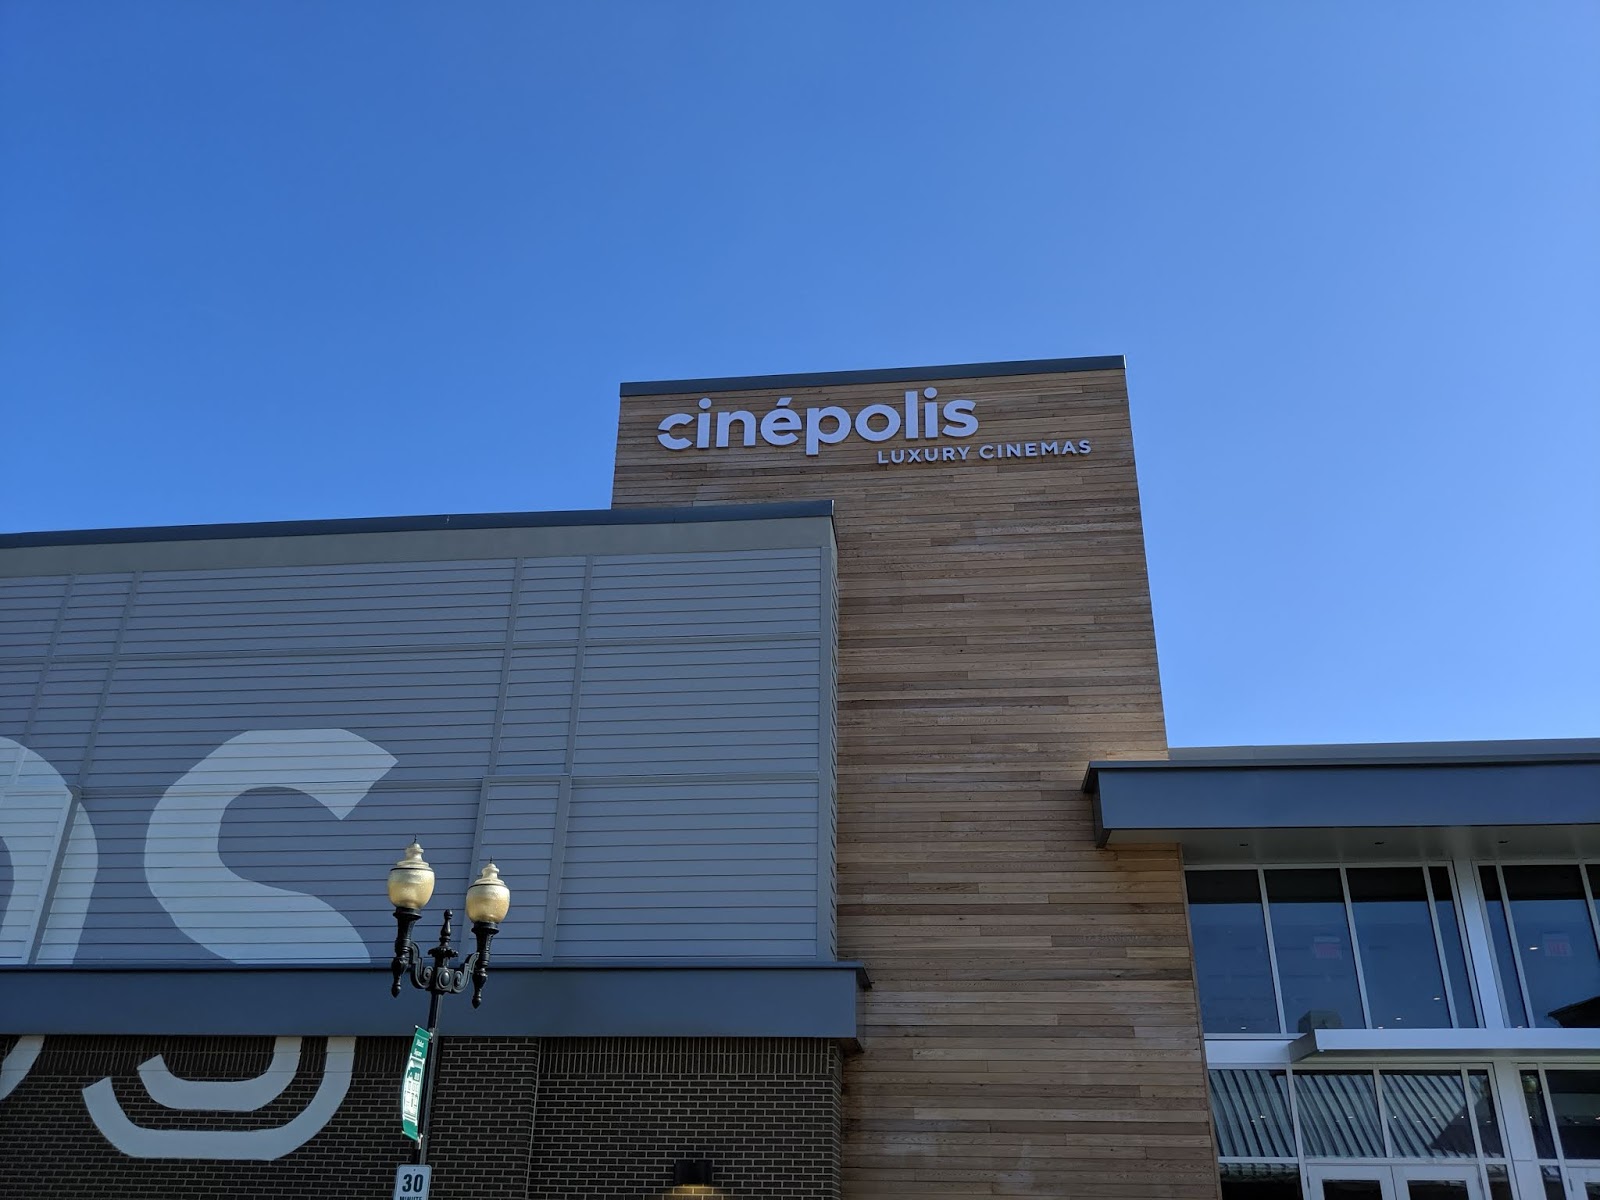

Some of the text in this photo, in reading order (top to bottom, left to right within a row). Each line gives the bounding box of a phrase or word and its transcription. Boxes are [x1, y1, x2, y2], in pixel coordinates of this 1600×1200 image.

[657, 387, 979, 456] cinépolis
[877, 439, 1092, 465] LUXURY CINEMAS
[402, 1173, 424, 1193] 30
